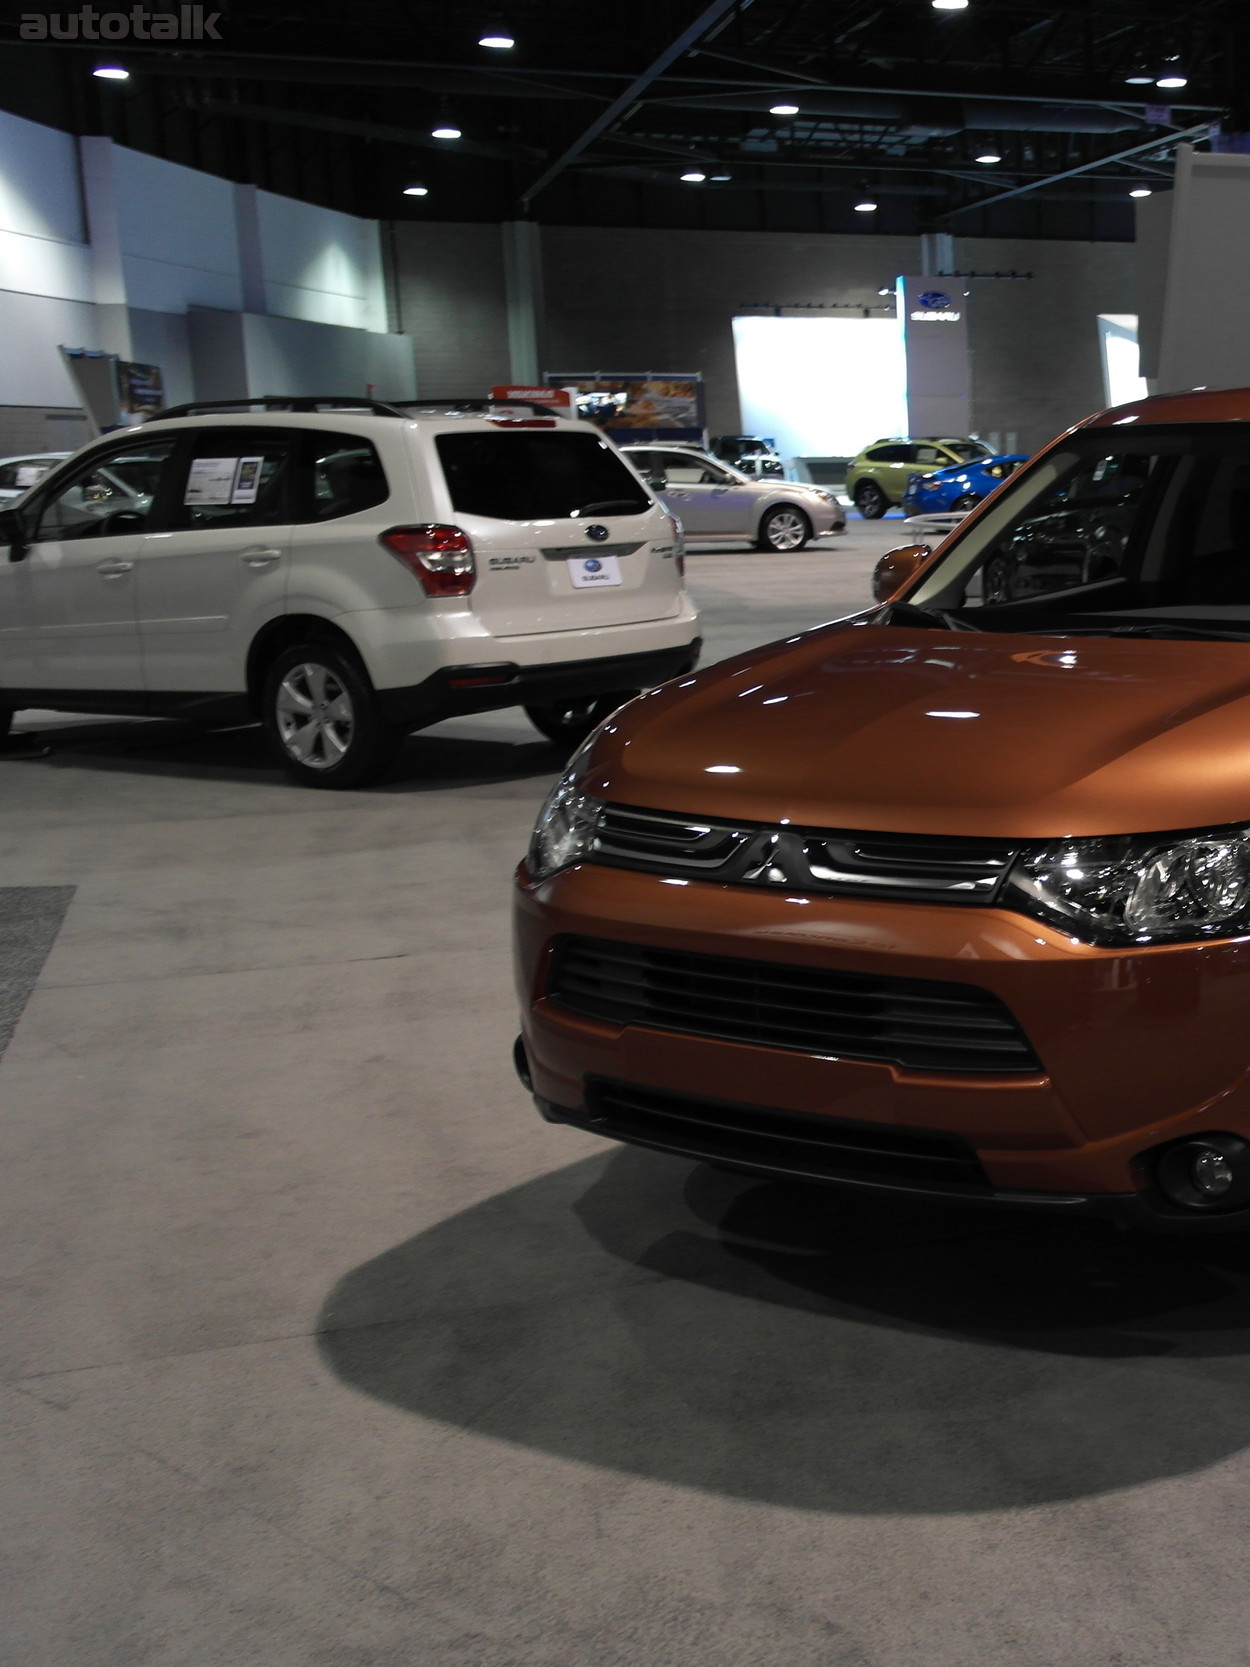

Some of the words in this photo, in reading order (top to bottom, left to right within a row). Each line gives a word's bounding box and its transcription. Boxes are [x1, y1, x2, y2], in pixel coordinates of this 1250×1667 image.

[910, 311, 960, 321] SUBARU
[488, 556, 536, 566] SUBARU
[582, 574, 610, 582] SUBARU
